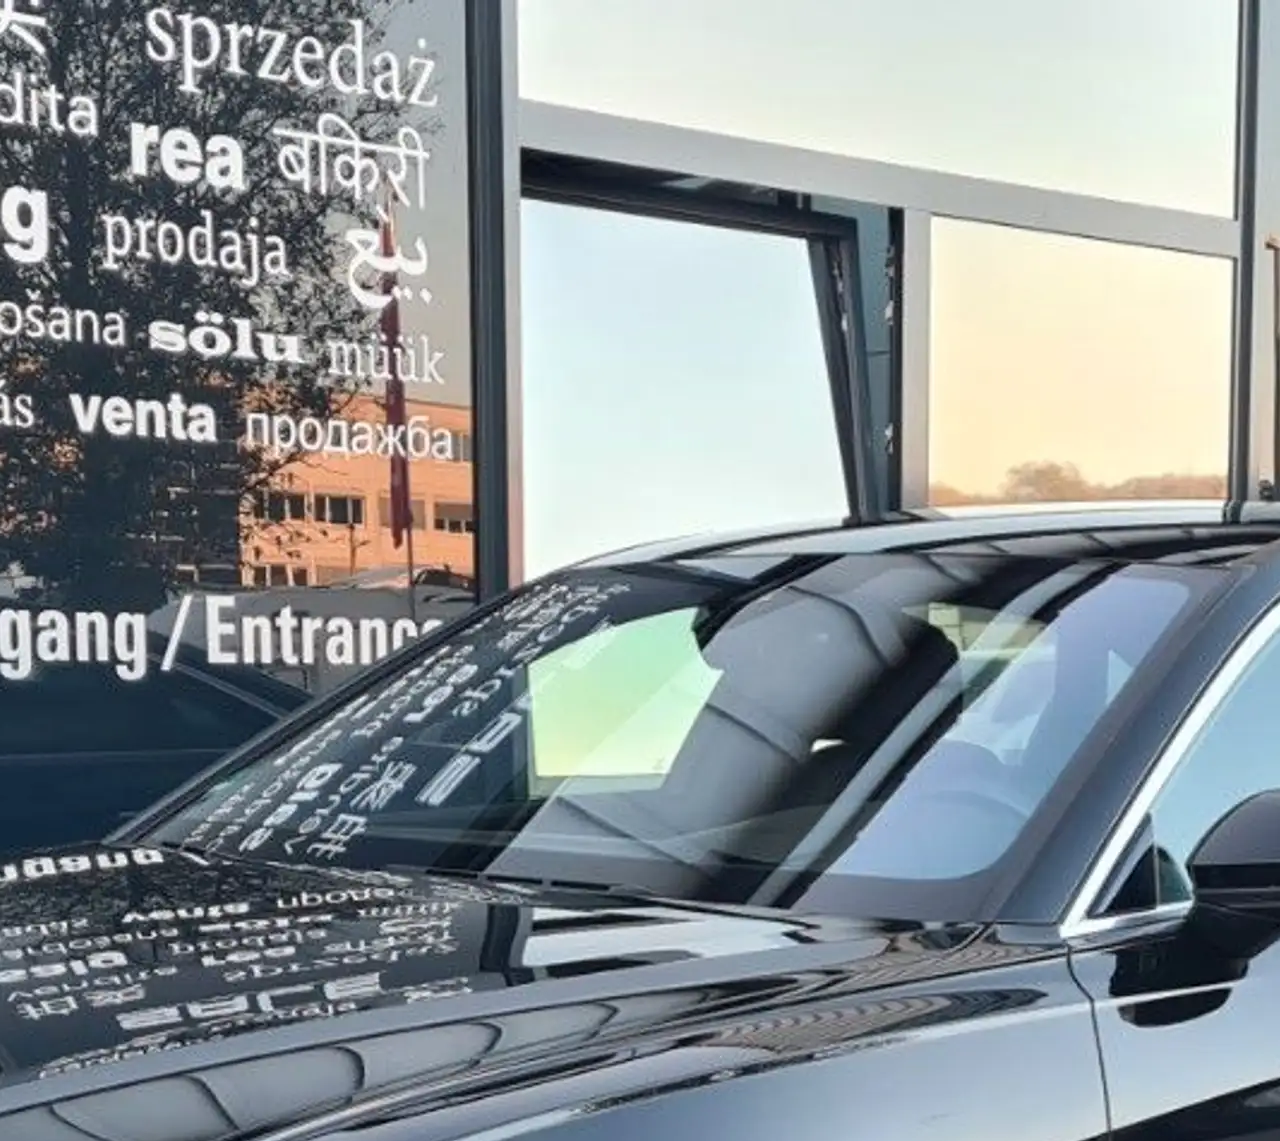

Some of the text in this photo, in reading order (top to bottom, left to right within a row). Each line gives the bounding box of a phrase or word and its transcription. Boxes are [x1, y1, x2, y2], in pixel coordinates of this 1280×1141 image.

[145, 7, 438, 108] sprzedaż
[130, 121, 246, 191] rea
[101, 209, 293, 288] prodaja
[148, 310, 306, 364] sölu
[326, 332, 446, 385] müük
[69, 392, 218, 444] venta
[245, 410, 455, 463] продажба
[206, 593, 443, 665] Entranc
